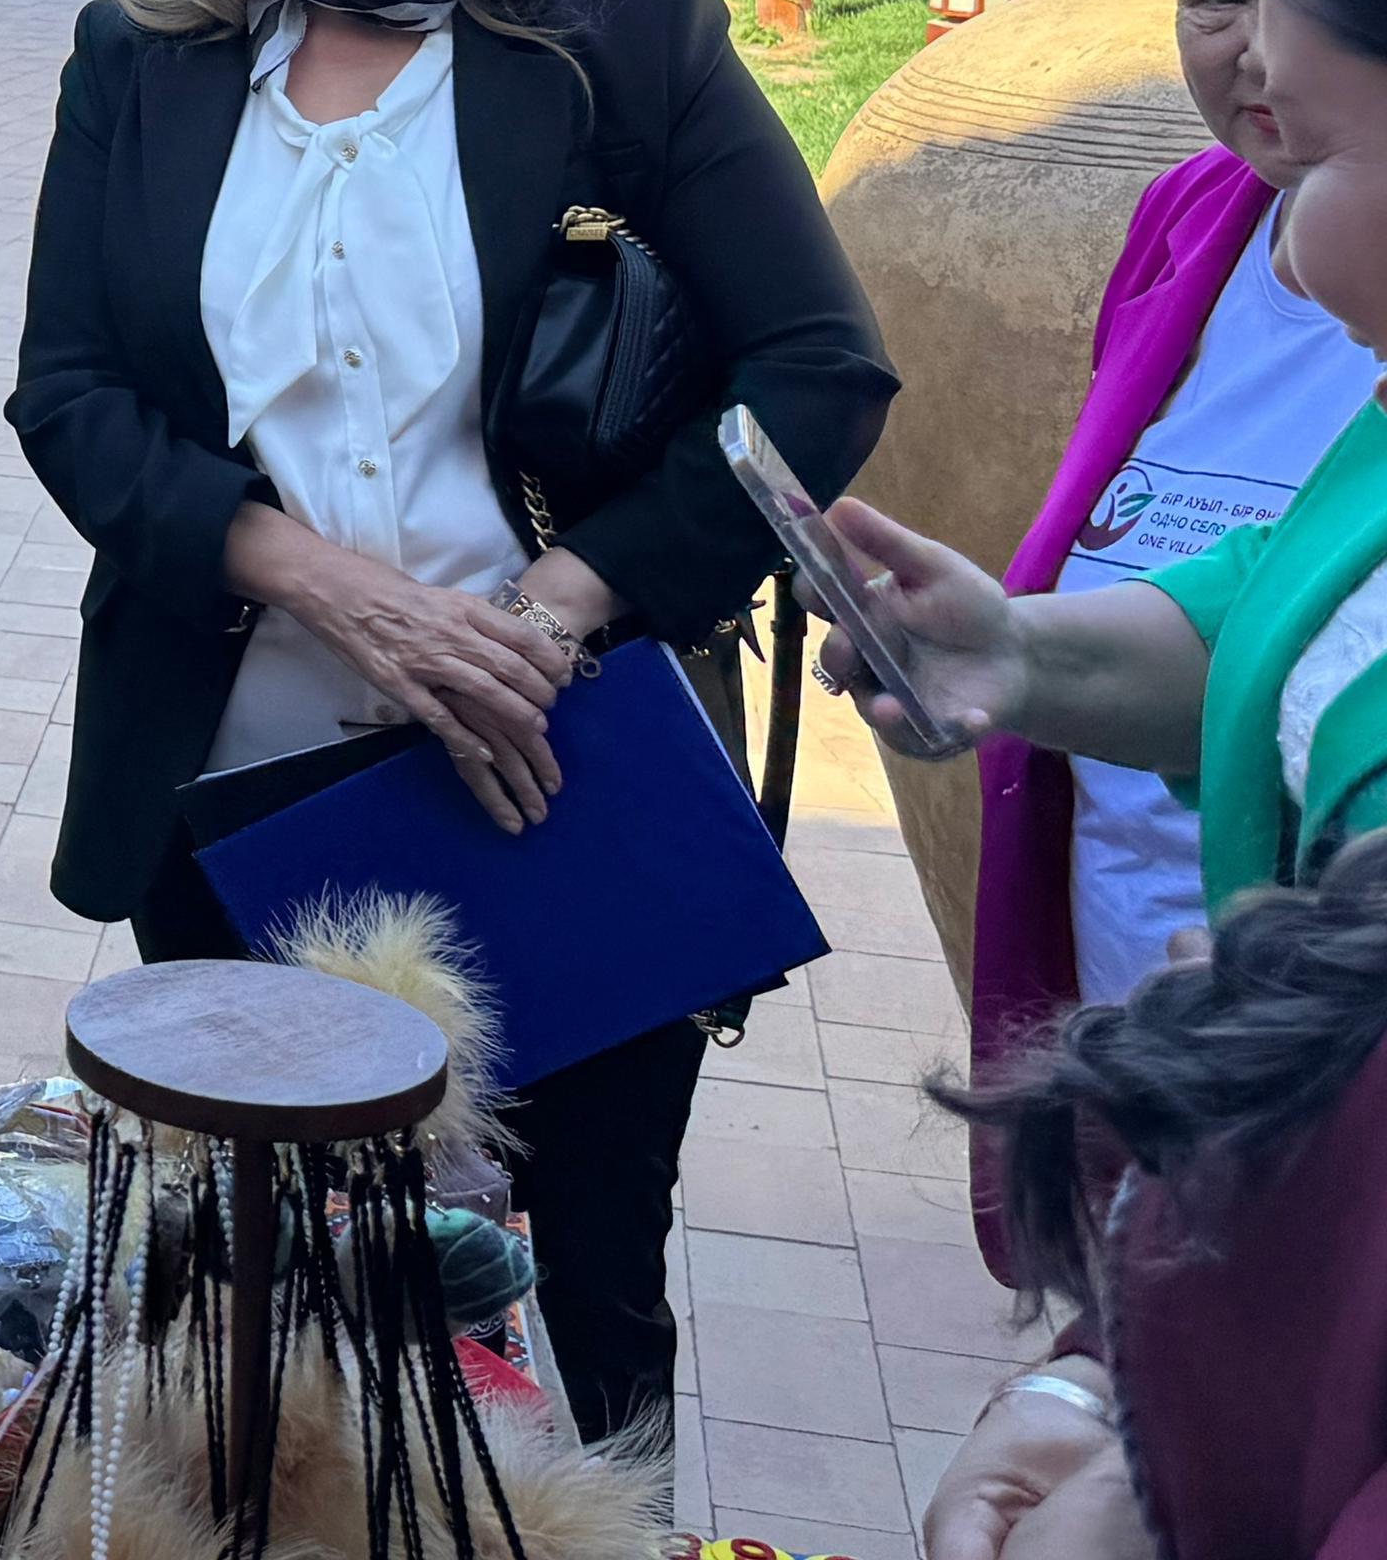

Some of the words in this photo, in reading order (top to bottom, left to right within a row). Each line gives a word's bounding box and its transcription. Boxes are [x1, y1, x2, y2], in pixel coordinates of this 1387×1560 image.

[1255, 508, 1282, 521] ӨН
[1150, 511, 1188, 529] ОДНО
[1190, 519, 1227, 536] СЕЛО
[1138, 533, 1168, 549] ONE
